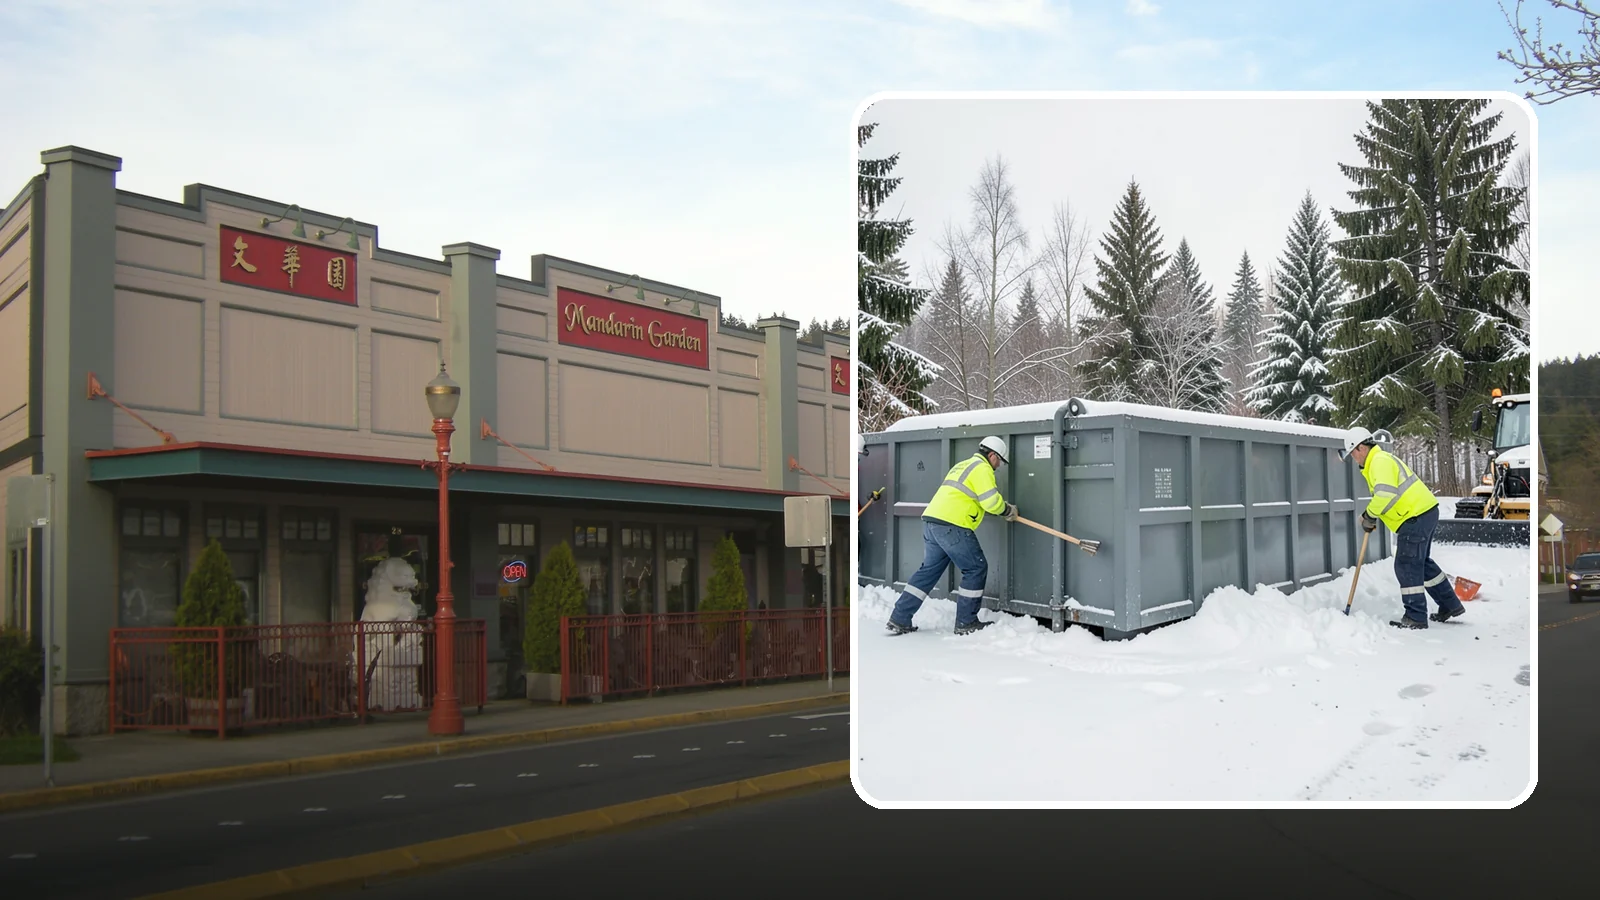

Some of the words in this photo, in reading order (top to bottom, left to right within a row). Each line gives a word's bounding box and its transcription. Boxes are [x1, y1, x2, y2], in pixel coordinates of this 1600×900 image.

[231, 236, 346, 291] 文華園
[564, 302, 644, 340] Mandarin
[647, 320, 702, 352] Garden
[503, 565, 527, 578] OPEN
